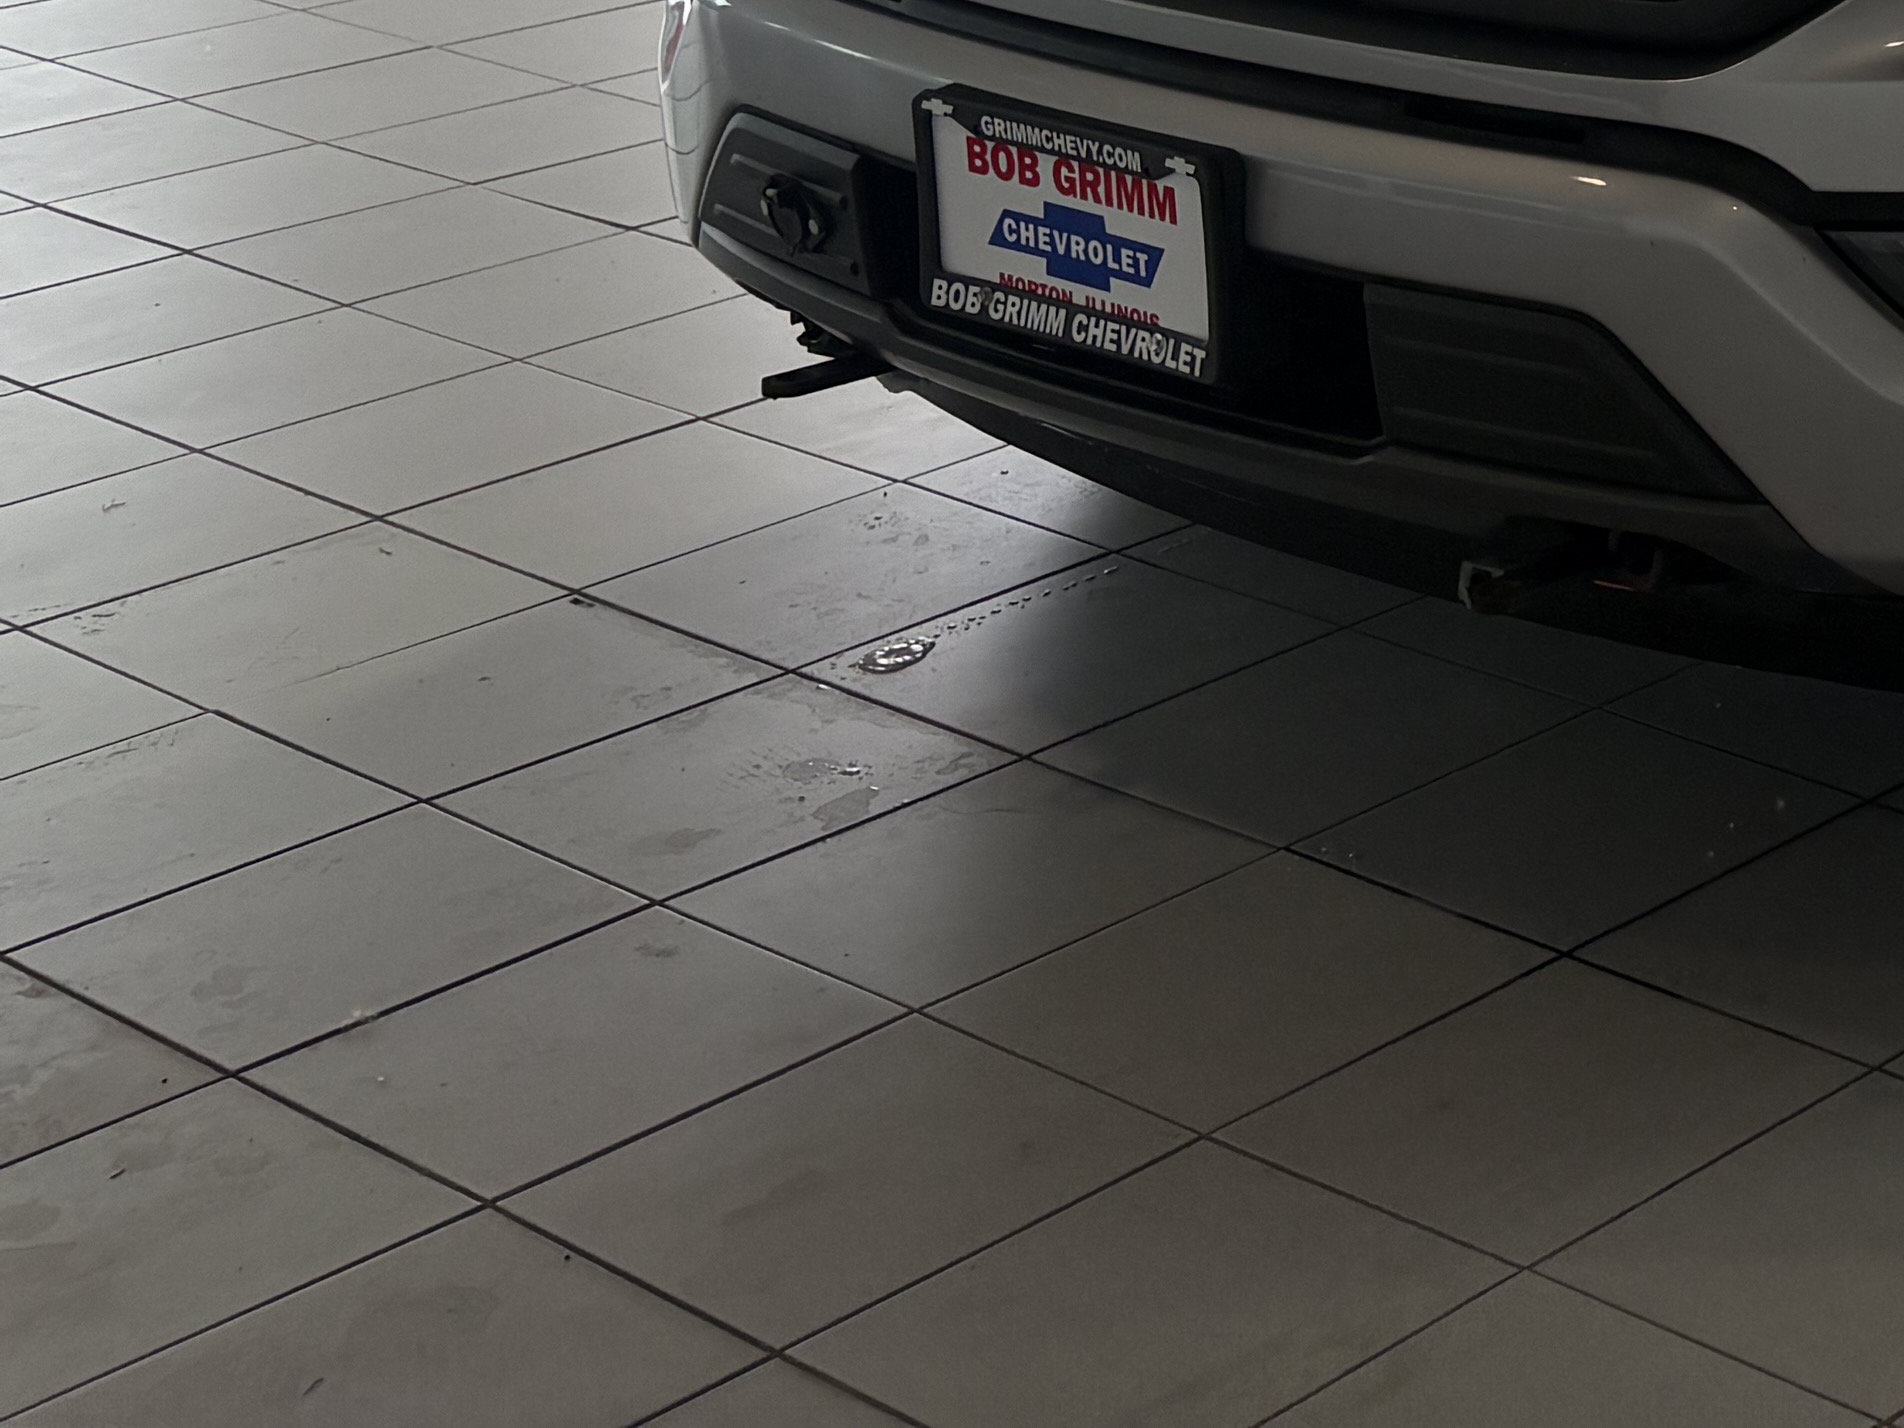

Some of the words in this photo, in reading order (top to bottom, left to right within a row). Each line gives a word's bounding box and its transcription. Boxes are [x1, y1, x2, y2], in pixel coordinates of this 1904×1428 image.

[966, 136, 1041, 188] BOB
[1052, 156, 1178, 226] GRIMM
[980, 115, 1141, 173] GRIMMCHEVY.COM
[1002, 217, 1149, 278] CHEVROLET
[930, 277, 982, 315] BOB
[988, 291, 1066, 337] GRIMM
[1070, 313, 1207, 379] CHEVROLET
